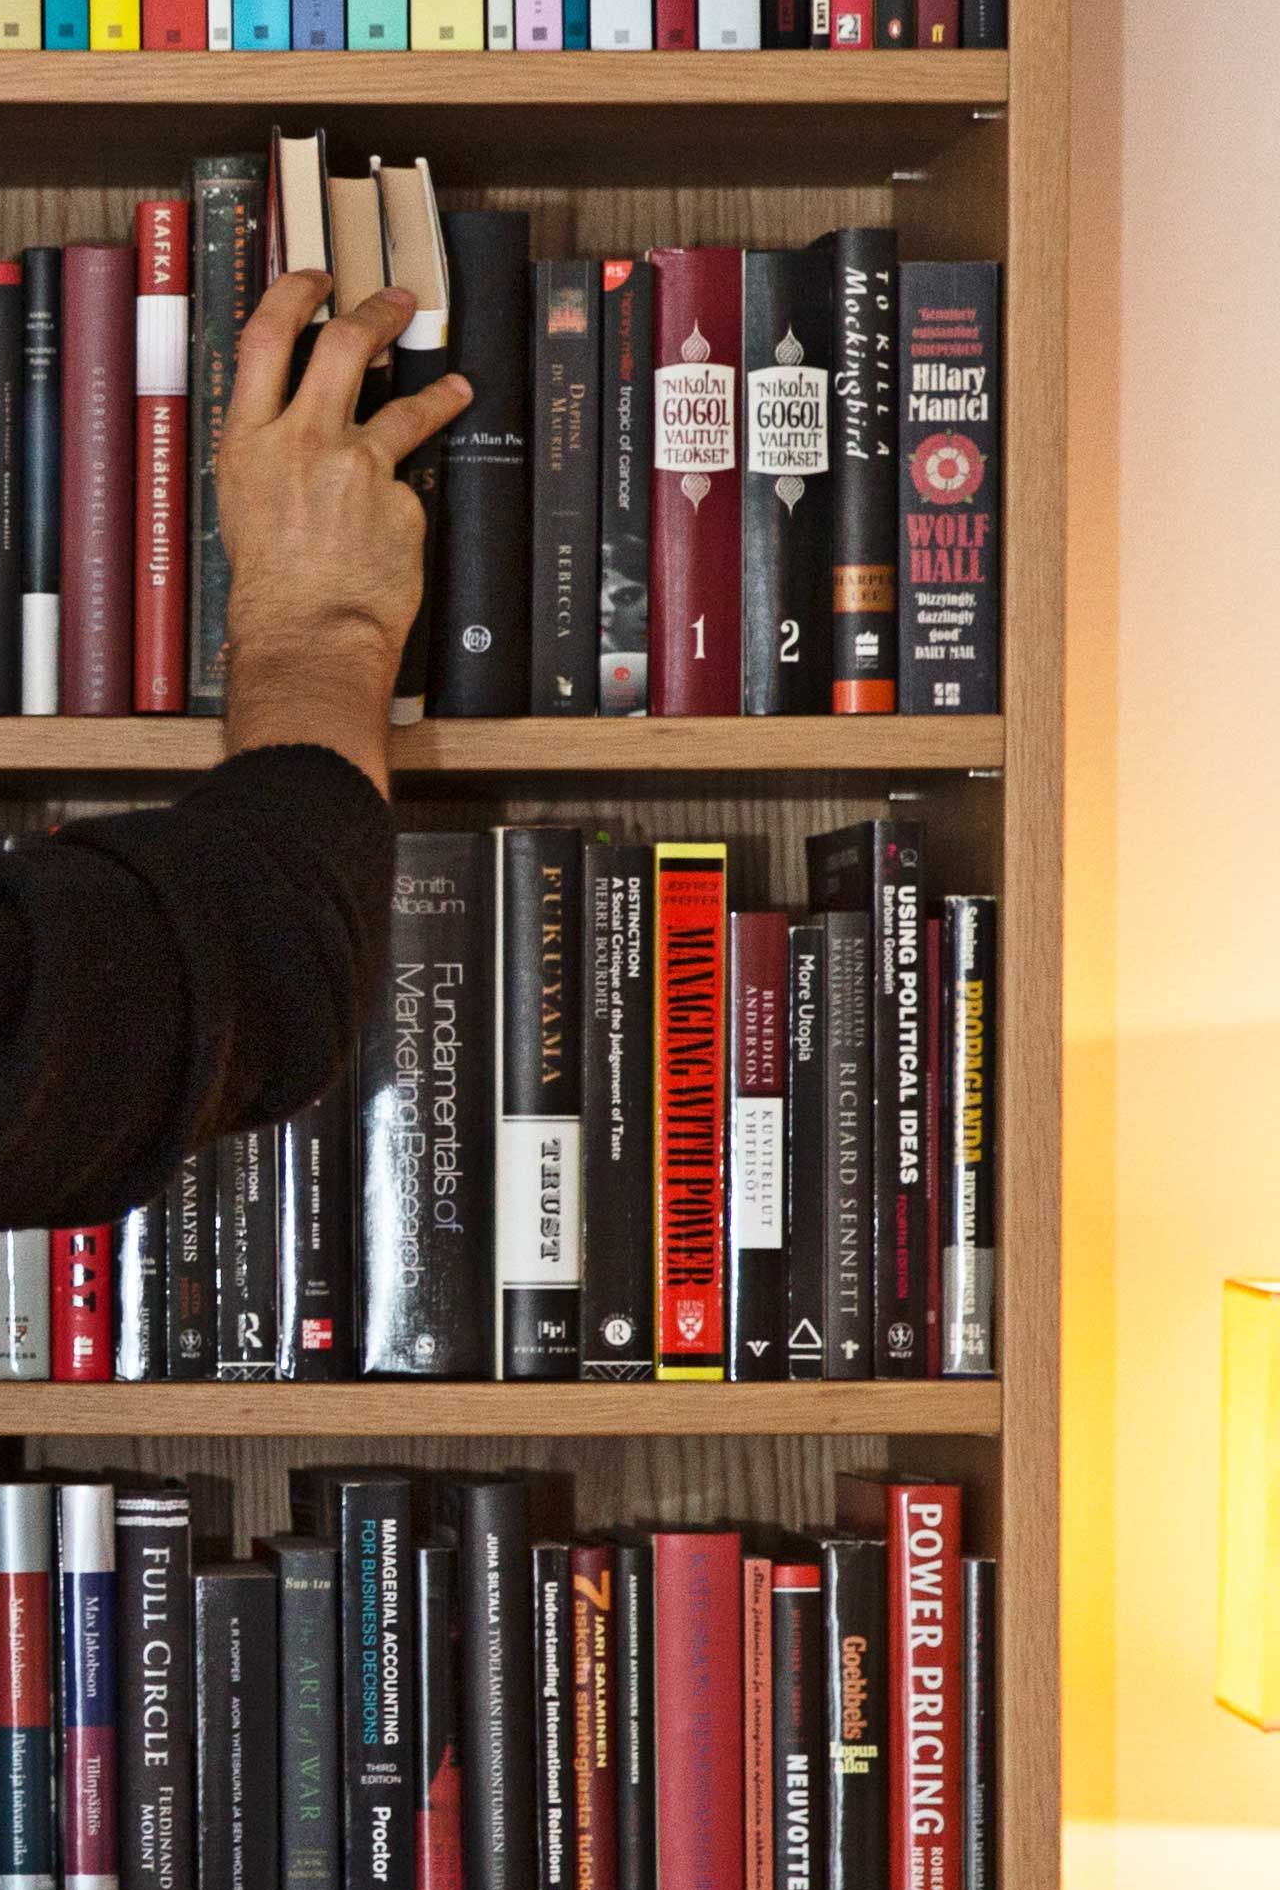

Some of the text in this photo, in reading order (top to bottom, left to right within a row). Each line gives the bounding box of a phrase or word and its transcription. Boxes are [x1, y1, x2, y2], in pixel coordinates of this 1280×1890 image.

[152, 209, 171, 587] KAFKA Nälkätaiteilija
[837, 266, 868, 459] Mockingbird
[877, 271, 889, 457] TO KILL A
[908, 395, 987, 421] Mantel
[912, 363, 985, 392] Hilary
[906, 514, 990, 548] WOLF
[910, 549, 984, 583] HALL
[541, 867, 562, 1084] FUKUYAMA
[628, 877, 641, 978] DISTINCTION
[797, 955, 816, 1061] More Utopia
[884, 885, 894, 994] Barbara Goodwin
[667, 926, 715, 1287] MANAGING WITH POWER
[898, 885, 917, 1184] USING POLITICAL IDEAS
[541, 1138, 561, 1262] TRUST
[839, 1061, 858, 1318] RICHARD SENNETT
[143, 1546, 170, 1766] FULL CIRCLE
[361, 1520, 378, 1744] FOR BUSINESS DECISIONS
[380, 1519, 399, 1744] MANAGERIAL ACCOUNTING
[909, 1503, 945, 1835] POWER PRICING
[372, 1807, 390, 1880] Proctor
